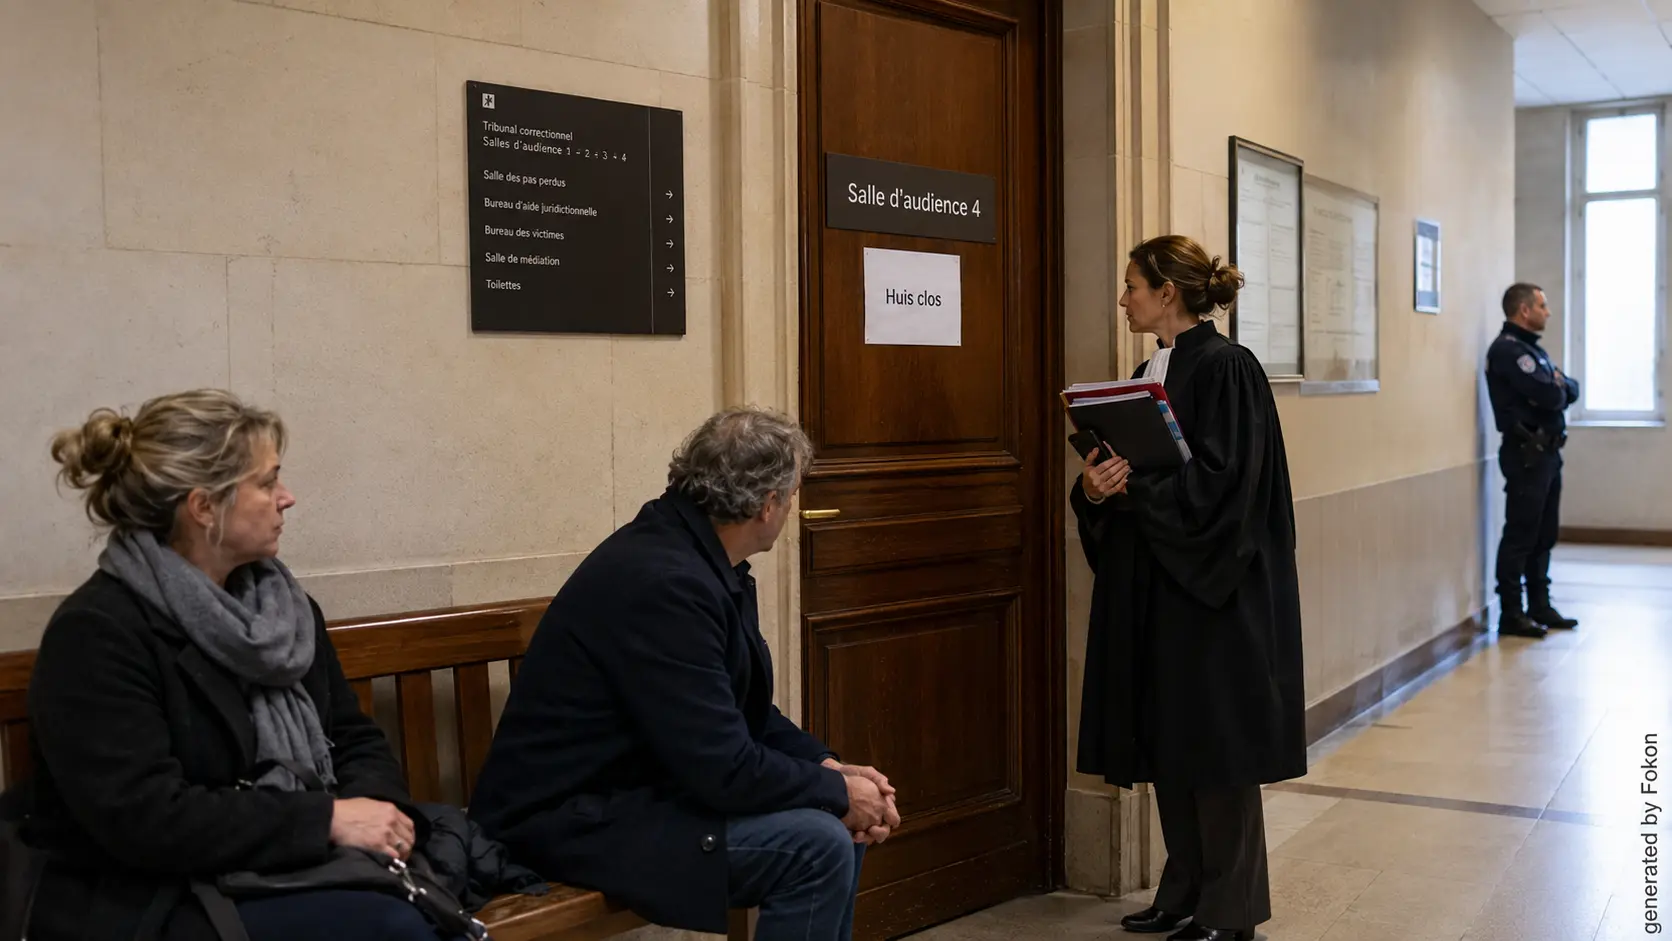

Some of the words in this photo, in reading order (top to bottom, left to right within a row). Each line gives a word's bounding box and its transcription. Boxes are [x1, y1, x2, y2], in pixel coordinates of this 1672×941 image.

[482, 120, 518, 134] Tribunal
[519, 127, 573, 141] correctionnel
[482, 136, 510, 149] Salles
[513, 139, 563, 155] d'audience
[584, 149, 590, 158] 2
[602, 150, 608, 160] 3
[621, 153, 627, 162] 4
[483, 169, 504, 181] Salle
[505, 172, 521, 183] des
[522, 175, 537, 186] pas
[538, 177, 567, 188] perdus
[484, 197, 514, 209] Bureau
[515, 200, 540, 212] d'aide
[541, 202, 598, 217] juridictionnelle
[848, 182, 885, 206] Salle
[889, 188, 968, 216] d'audience
[972, 200, 981, 217] 4
[484, 225, 514, 237] Bureau
[515, 228, 531, 239] des
[532, 229, 565, 241] victimes
[485, 252, 506, 264] Salle
[507, 254, 519, 264] de
[520, 254, 560, 266] médiation
[486, 279, 521, 291] Toilettes
[886, 288, 914, 306] Huis
[917, 290, 942, 307] clos
